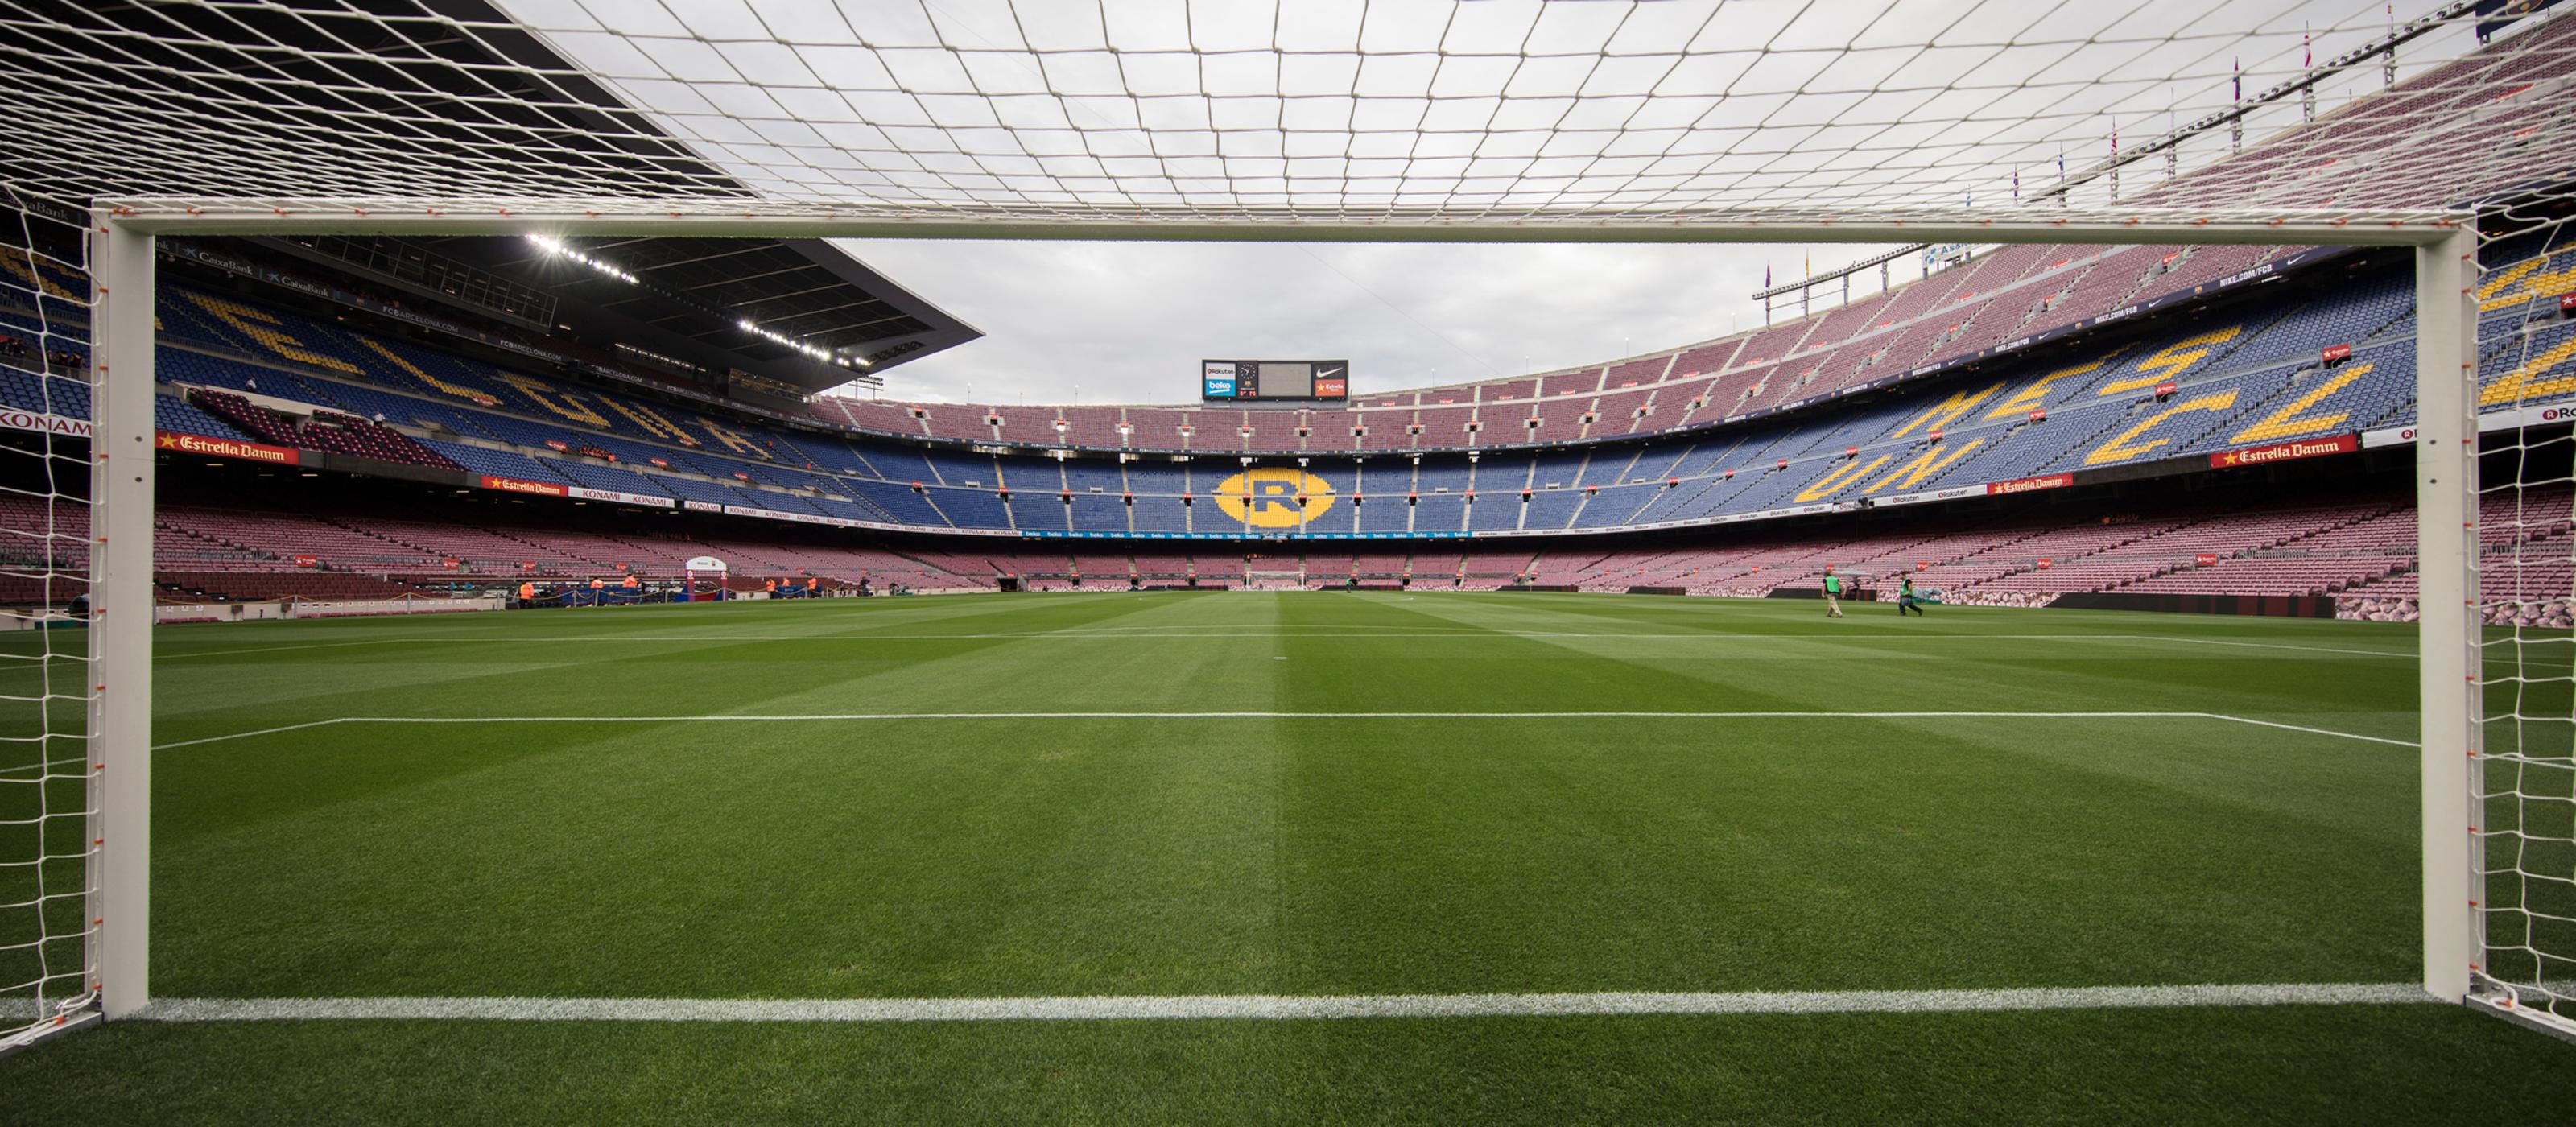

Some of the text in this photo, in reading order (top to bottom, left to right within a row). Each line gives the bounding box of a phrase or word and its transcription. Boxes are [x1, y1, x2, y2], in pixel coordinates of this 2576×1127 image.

[199, 252, 253, 275] CaixaBank
[2219, 264, 2273, 287] NIKE.COM/FCB
[282, 275, 329, 297] CaixaBank
[382, 306, 459, 332] FCBARCELONA.COM
[2095, 306, 2137, 324] NIKE.COM/FCB
[1209, 381, 1231, 389] beko
[0, 412, 91, 436] KONAM
[180, 436, 285, 461] Estrella Damm
[2239, 442, 2339, 463] Estrella Damm
[502, 480, 560, 495] Estrella Damm
[1943, 489, 1968, 497] Rakuten
[2004, 478, 2063, 493] Estrella Damm
[583, 489, 621, 501] KONAMI
[632, 495, 667, 506] KONAMI
[688, 502, 719, 511] KONAMI
[729, 507, 757, 515] KONAMI
